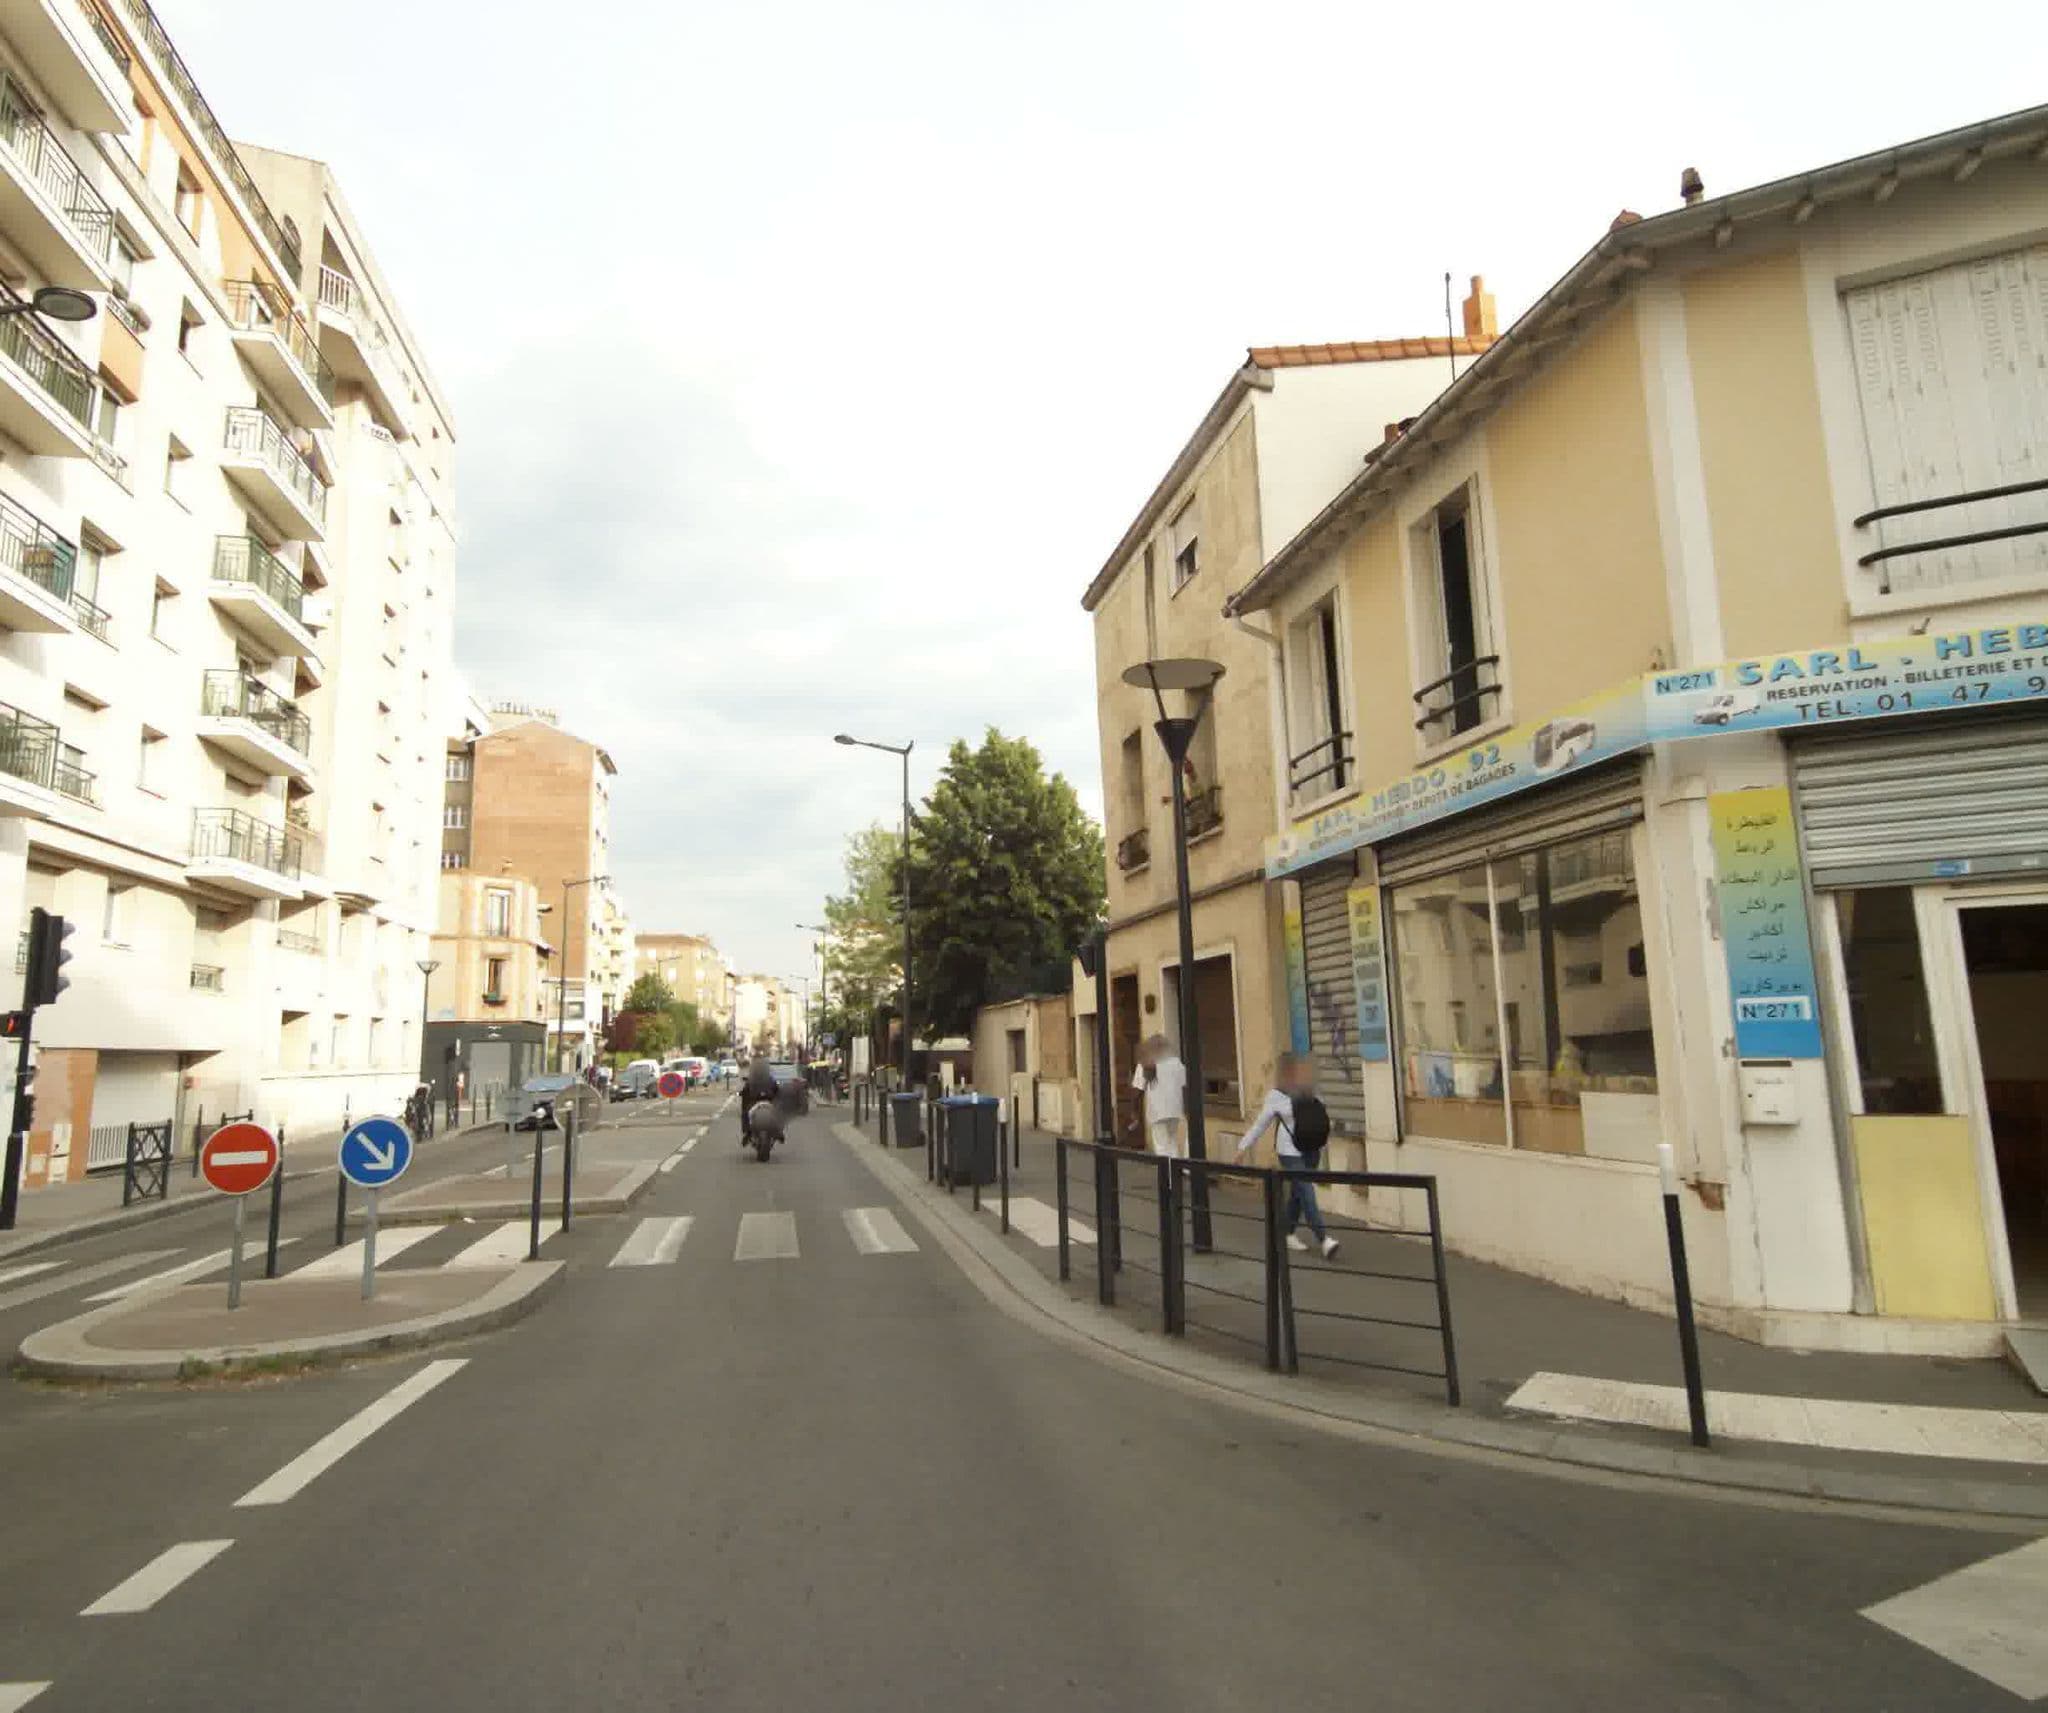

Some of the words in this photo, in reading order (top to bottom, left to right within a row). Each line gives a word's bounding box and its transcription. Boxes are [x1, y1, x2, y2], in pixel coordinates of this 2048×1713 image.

[1736, 648, 1878, 686] SARL
[1766, 676, 1888, 702] RESERVATION
[1905, 660, 2007, 684] BILLETERIE
[2012, 657, 2035, 671] ET
[1877, 690, 1913, 711] 01
[1952, 682, 1990, 702] 47
